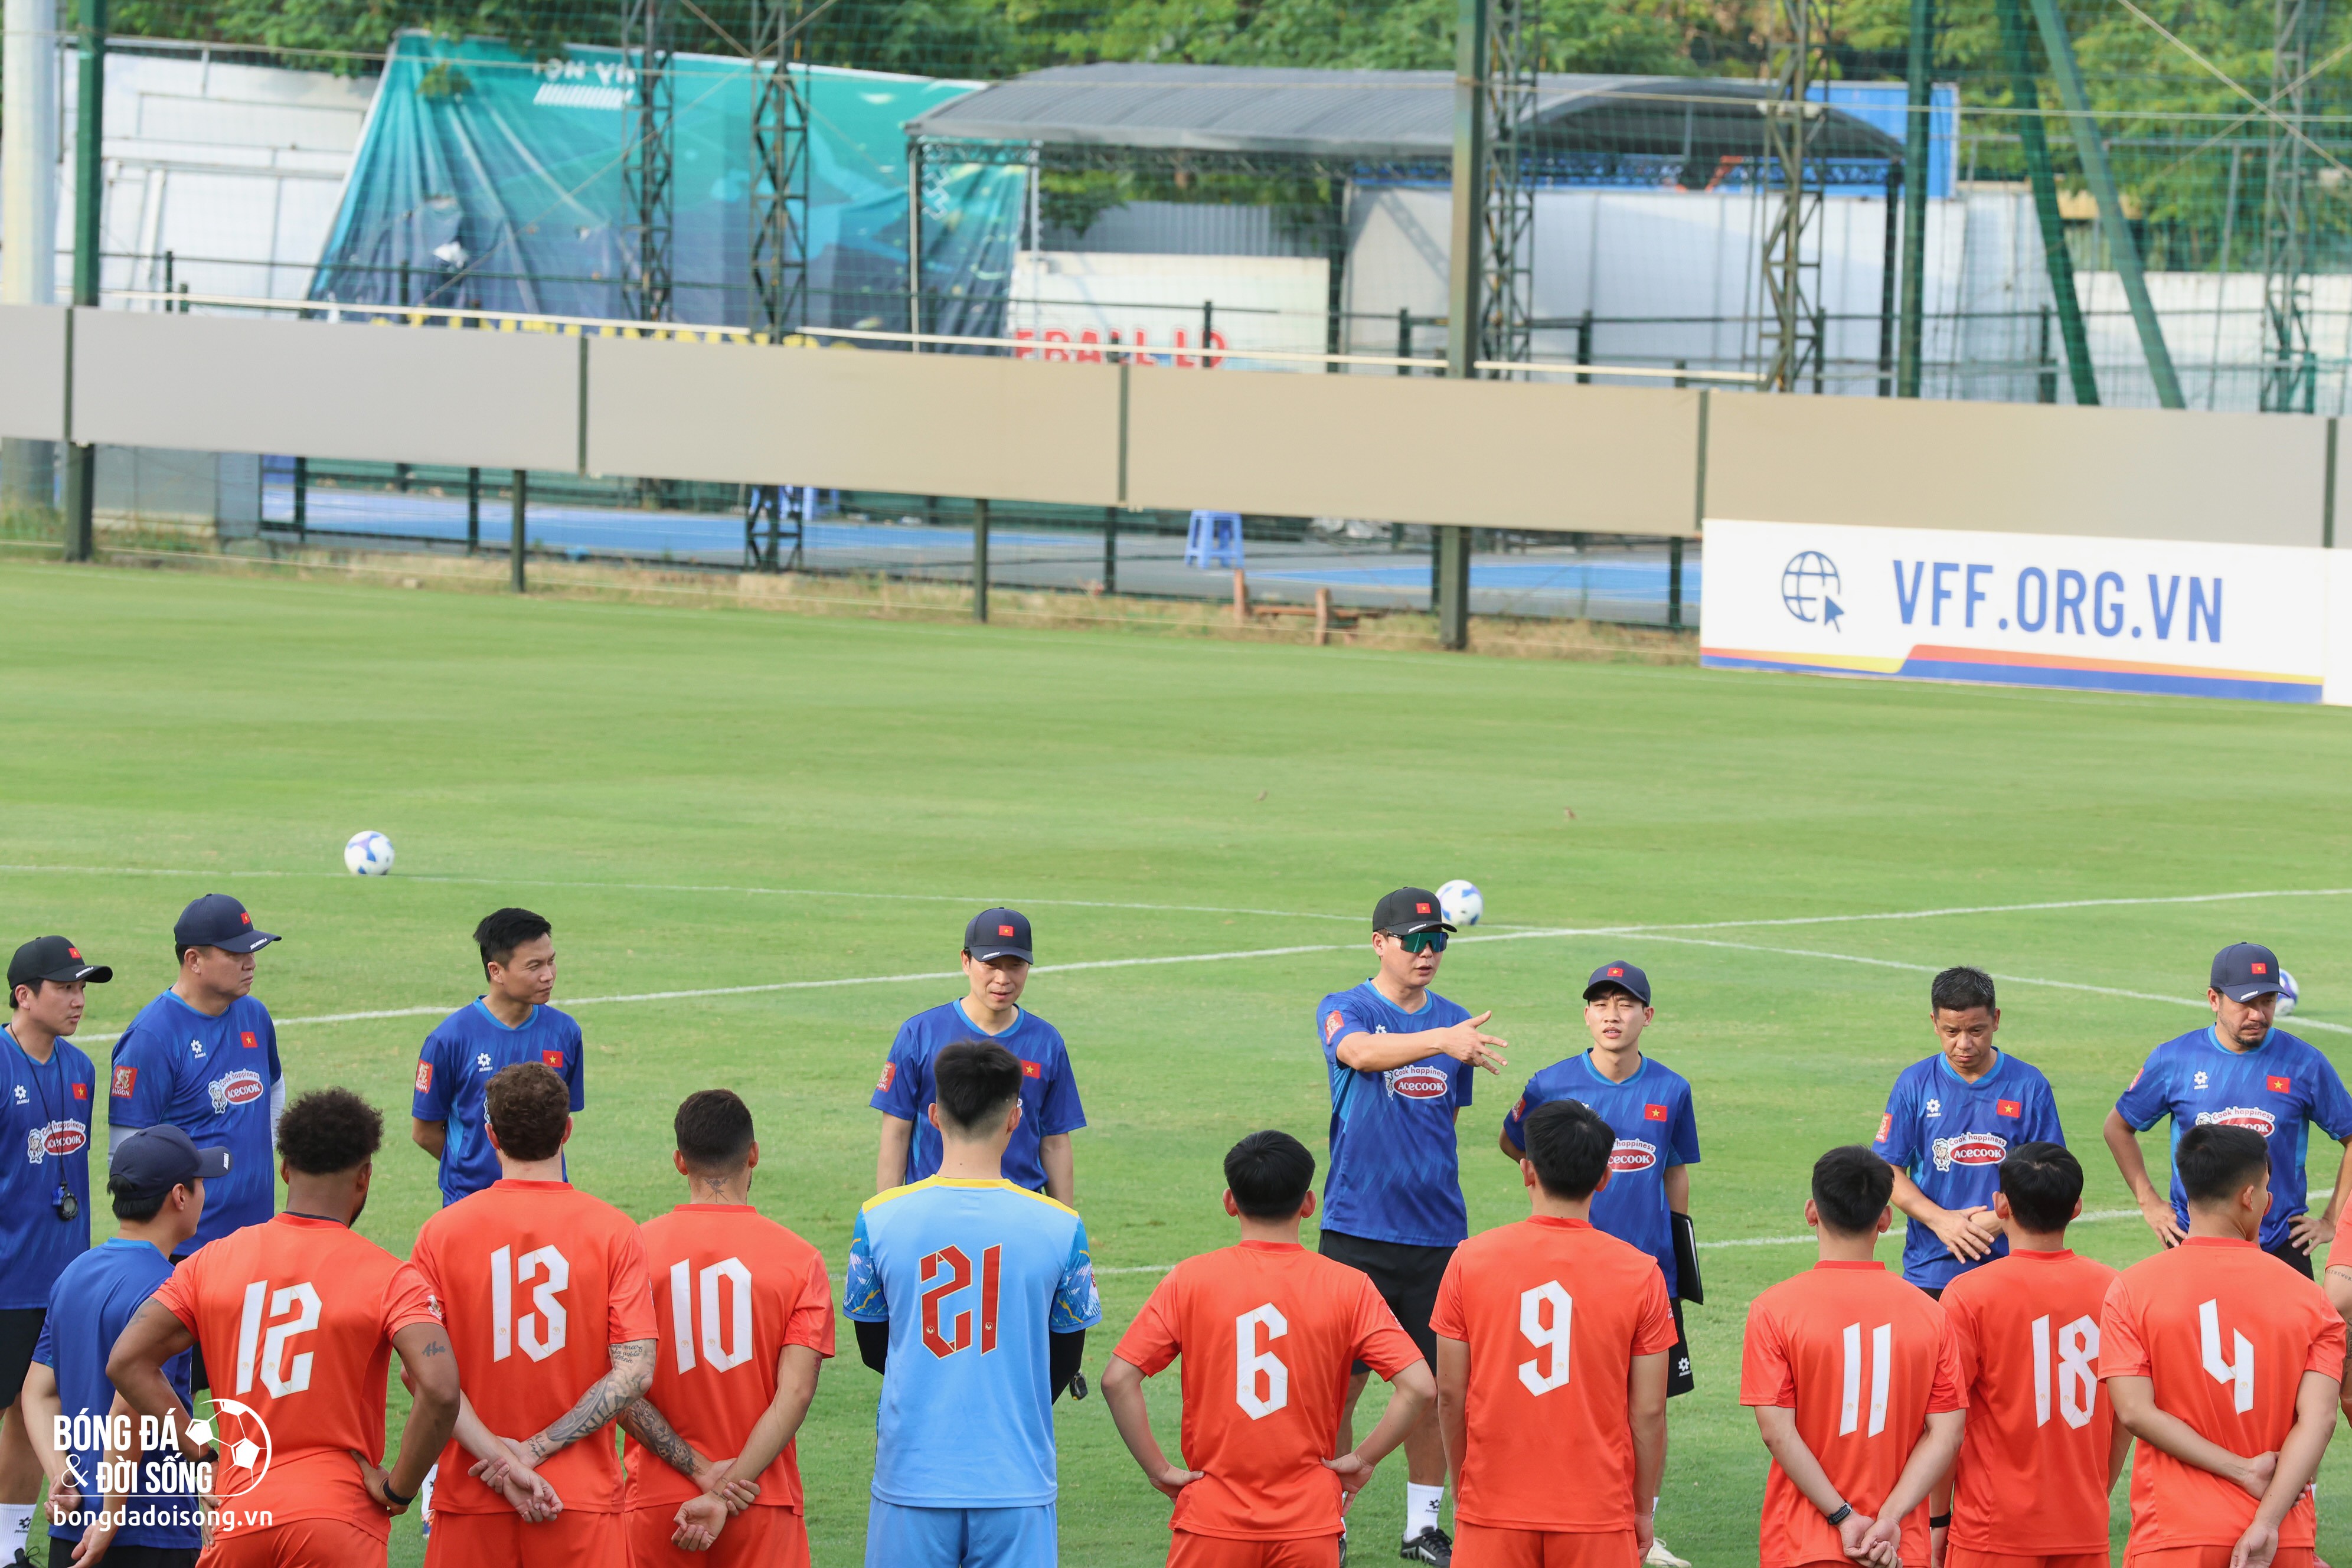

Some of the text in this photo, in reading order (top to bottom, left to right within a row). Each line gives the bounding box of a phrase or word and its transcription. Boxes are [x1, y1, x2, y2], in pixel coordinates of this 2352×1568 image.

[1893, 560, 2222, 643] VFF.ORG.VN
[1410, 1067, 1446, 1079] happiness
[2213, 1108, 2273, 1121] Cook happiness
[1616, 1139, 1655, 1151] happiness
[1949, 1133, 2005, 1146] Cook happiness
[236, 1279, 322, 1399] 12
[491, 1244, 570, 1363] 13
[670, 1256, 753, 1375] 10
[919, 1243, 1002, 1359] 21
[1517, 1279, 1573, 1397] 9
[2199, 1298, 2255, 1415] 4
[1235, 1302, 1289, 1420] 6
[1838, 1322, 1892, 1438] 11
[2031, 1314, 2101, 1430] 18
